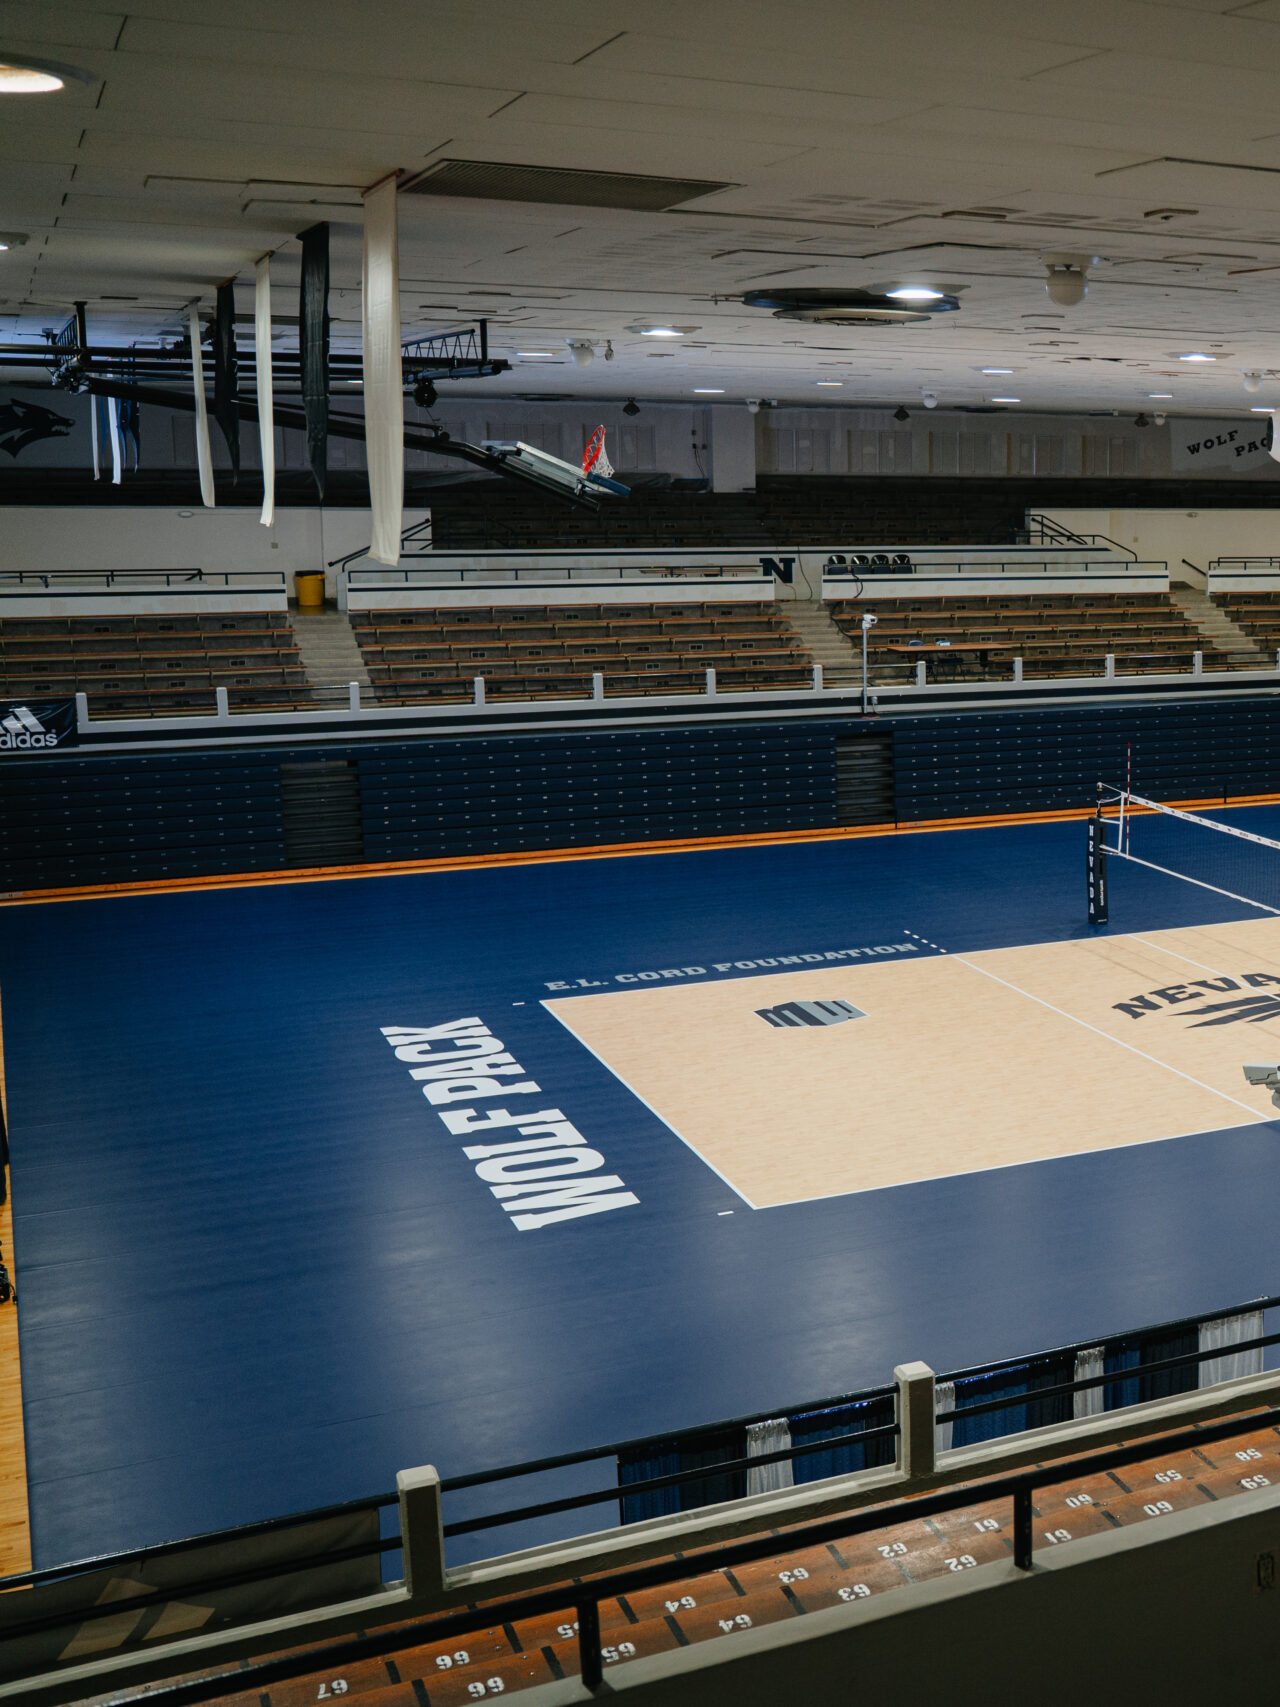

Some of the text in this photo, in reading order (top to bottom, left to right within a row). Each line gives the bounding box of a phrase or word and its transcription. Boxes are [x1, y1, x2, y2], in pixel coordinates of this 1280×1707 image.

[1186, 430, 1238, 455] WOLF
[759, 557, 796, 584] N
[0, 732, 58, 749] didas
[543, 943, 919, 992] E.L. CORD FOUNDATION
[379, 1016, 641, 1232] WOLF PACK
[1234, 1448, 1263, 1462] 58
[1154, 1469, 1183, 1483] 59
[1240, 1474, 1271, 1490] 59
[1065, 1493, 1093, 1508] 60
[1143, 1500, 1174, 1516] 60
[973, 1518, 999, 1533] 61
[1044, 1528, 1073, 1545] 61
[877, 1542, 909, 1559] 62
[943, 1554, 977, 1572] 62
[778, 1567, 809, 1584] 63
[837, 1583, 871, 1601] 63
[664, 1596, 697, 1613] 64
[718, 1614, 752, 1633] 64
[435, 1650, 470, 1670] 66
[601, 1642, 636, 1663] 65
[317, 1679, 348, 1700] 67
[467, 1676, 505, 1696] 66
